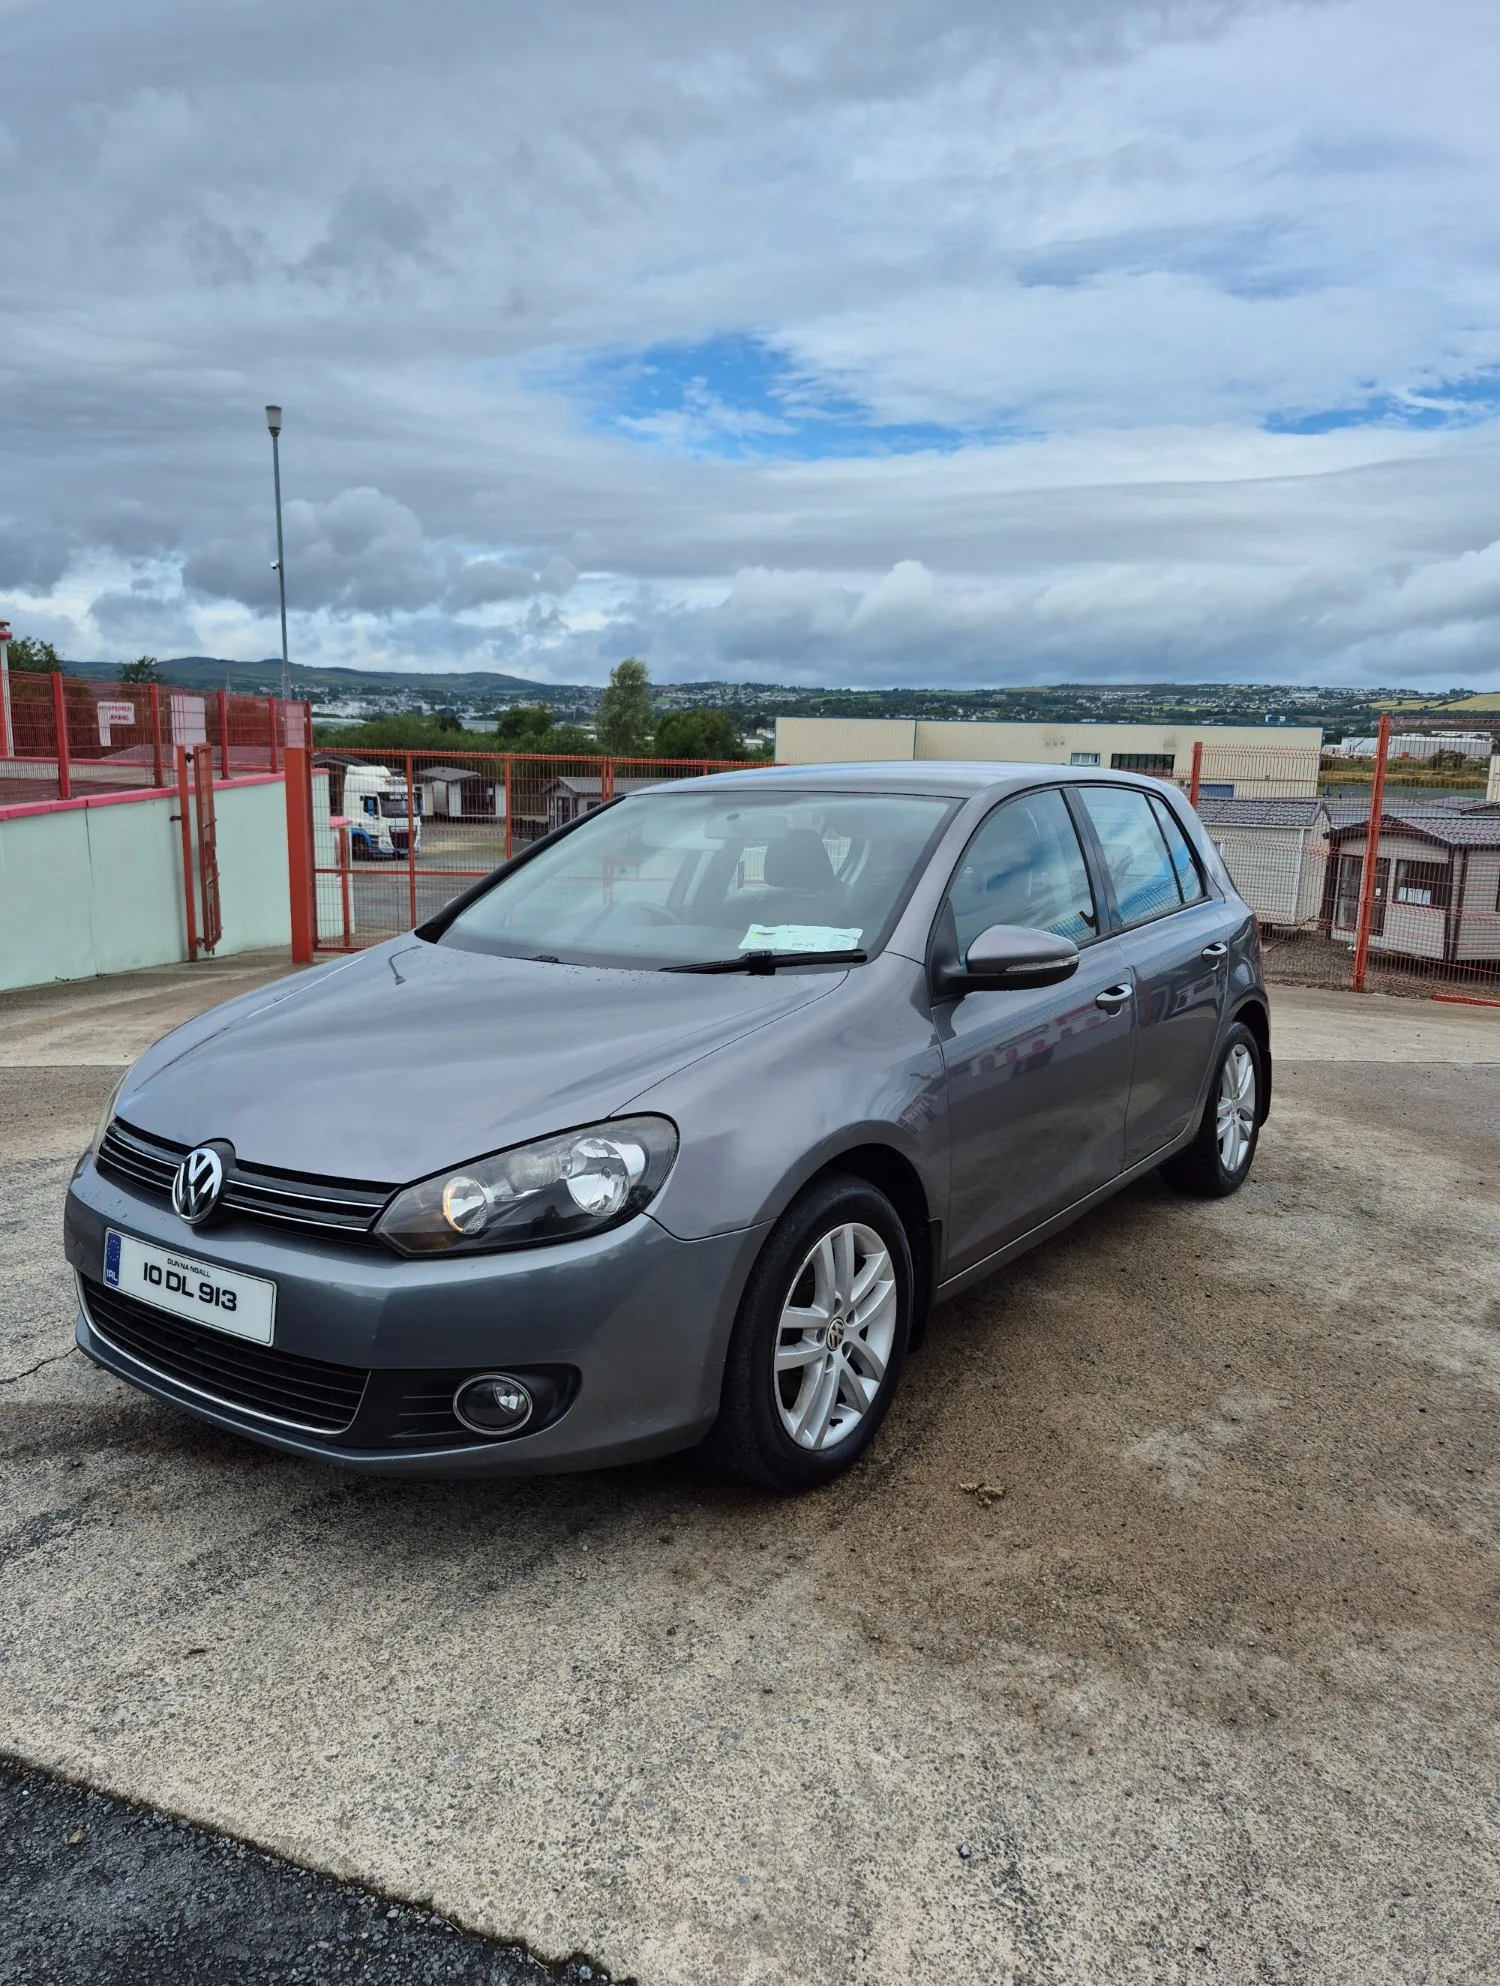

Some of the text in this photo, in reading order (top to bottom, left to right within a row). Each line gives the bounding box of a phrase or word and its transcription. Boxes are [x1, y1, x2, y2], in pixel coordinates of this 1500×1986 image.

[174, 1148, 222, 1223] VW
[106, 1269, 119, 1282] IRL
[180, 1262, 190, 1271] NA
[190, 1266, 211, 1278] NGALL
[143, 1262, 238, 1312] 10 DL 913
